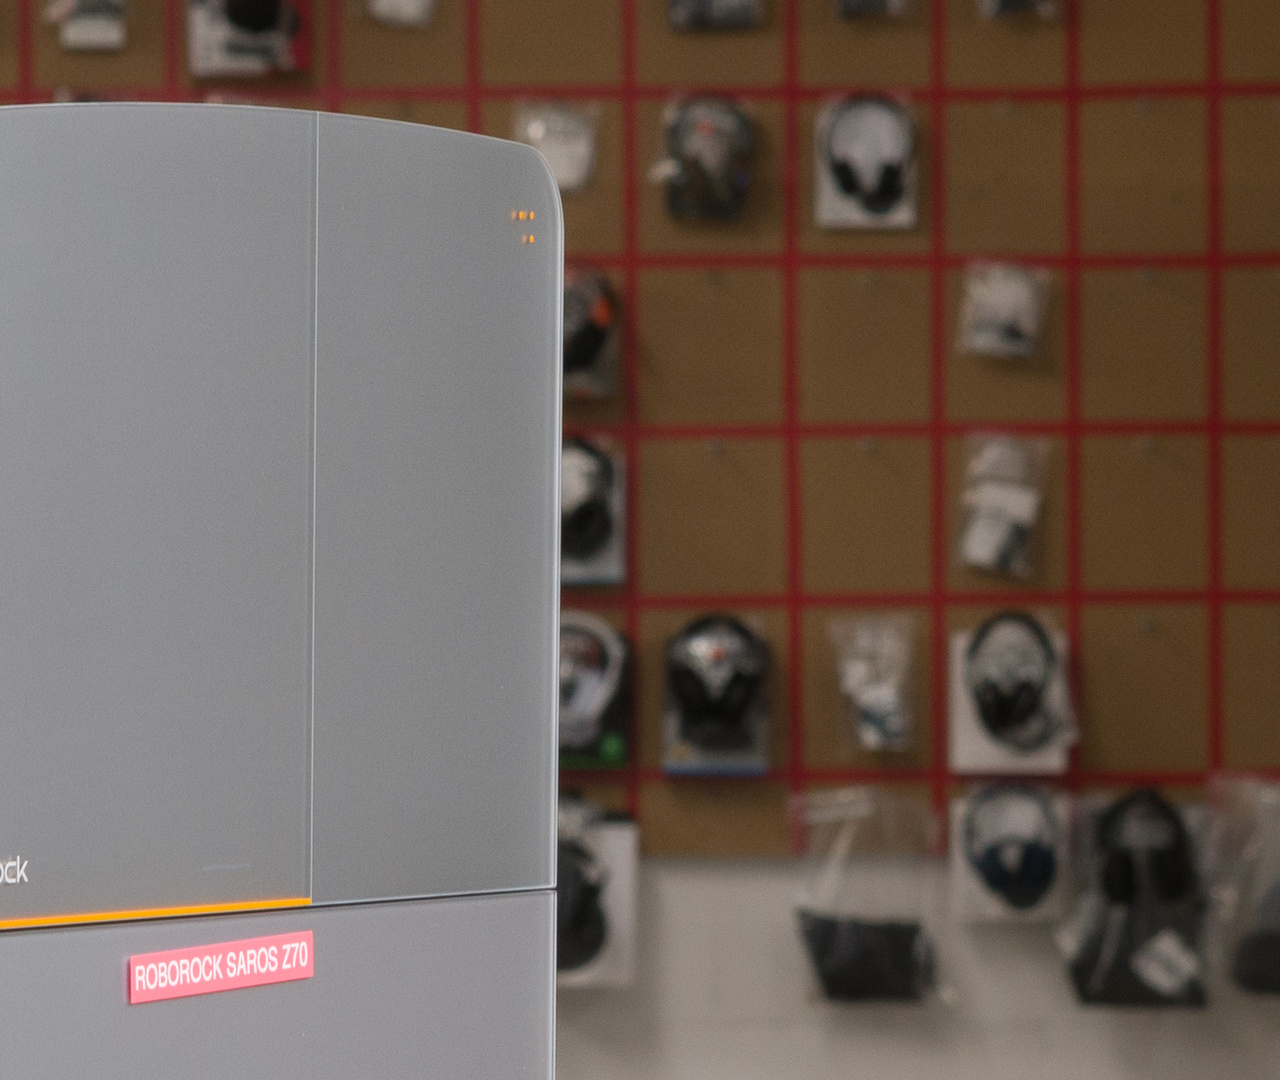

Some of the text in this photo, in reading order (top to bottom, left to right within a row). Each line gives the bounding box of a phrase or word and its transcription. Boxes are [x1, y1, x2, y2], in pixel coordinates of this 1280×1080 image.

[135, 941, 308, 991] ROBOROCK SAROS Z70
